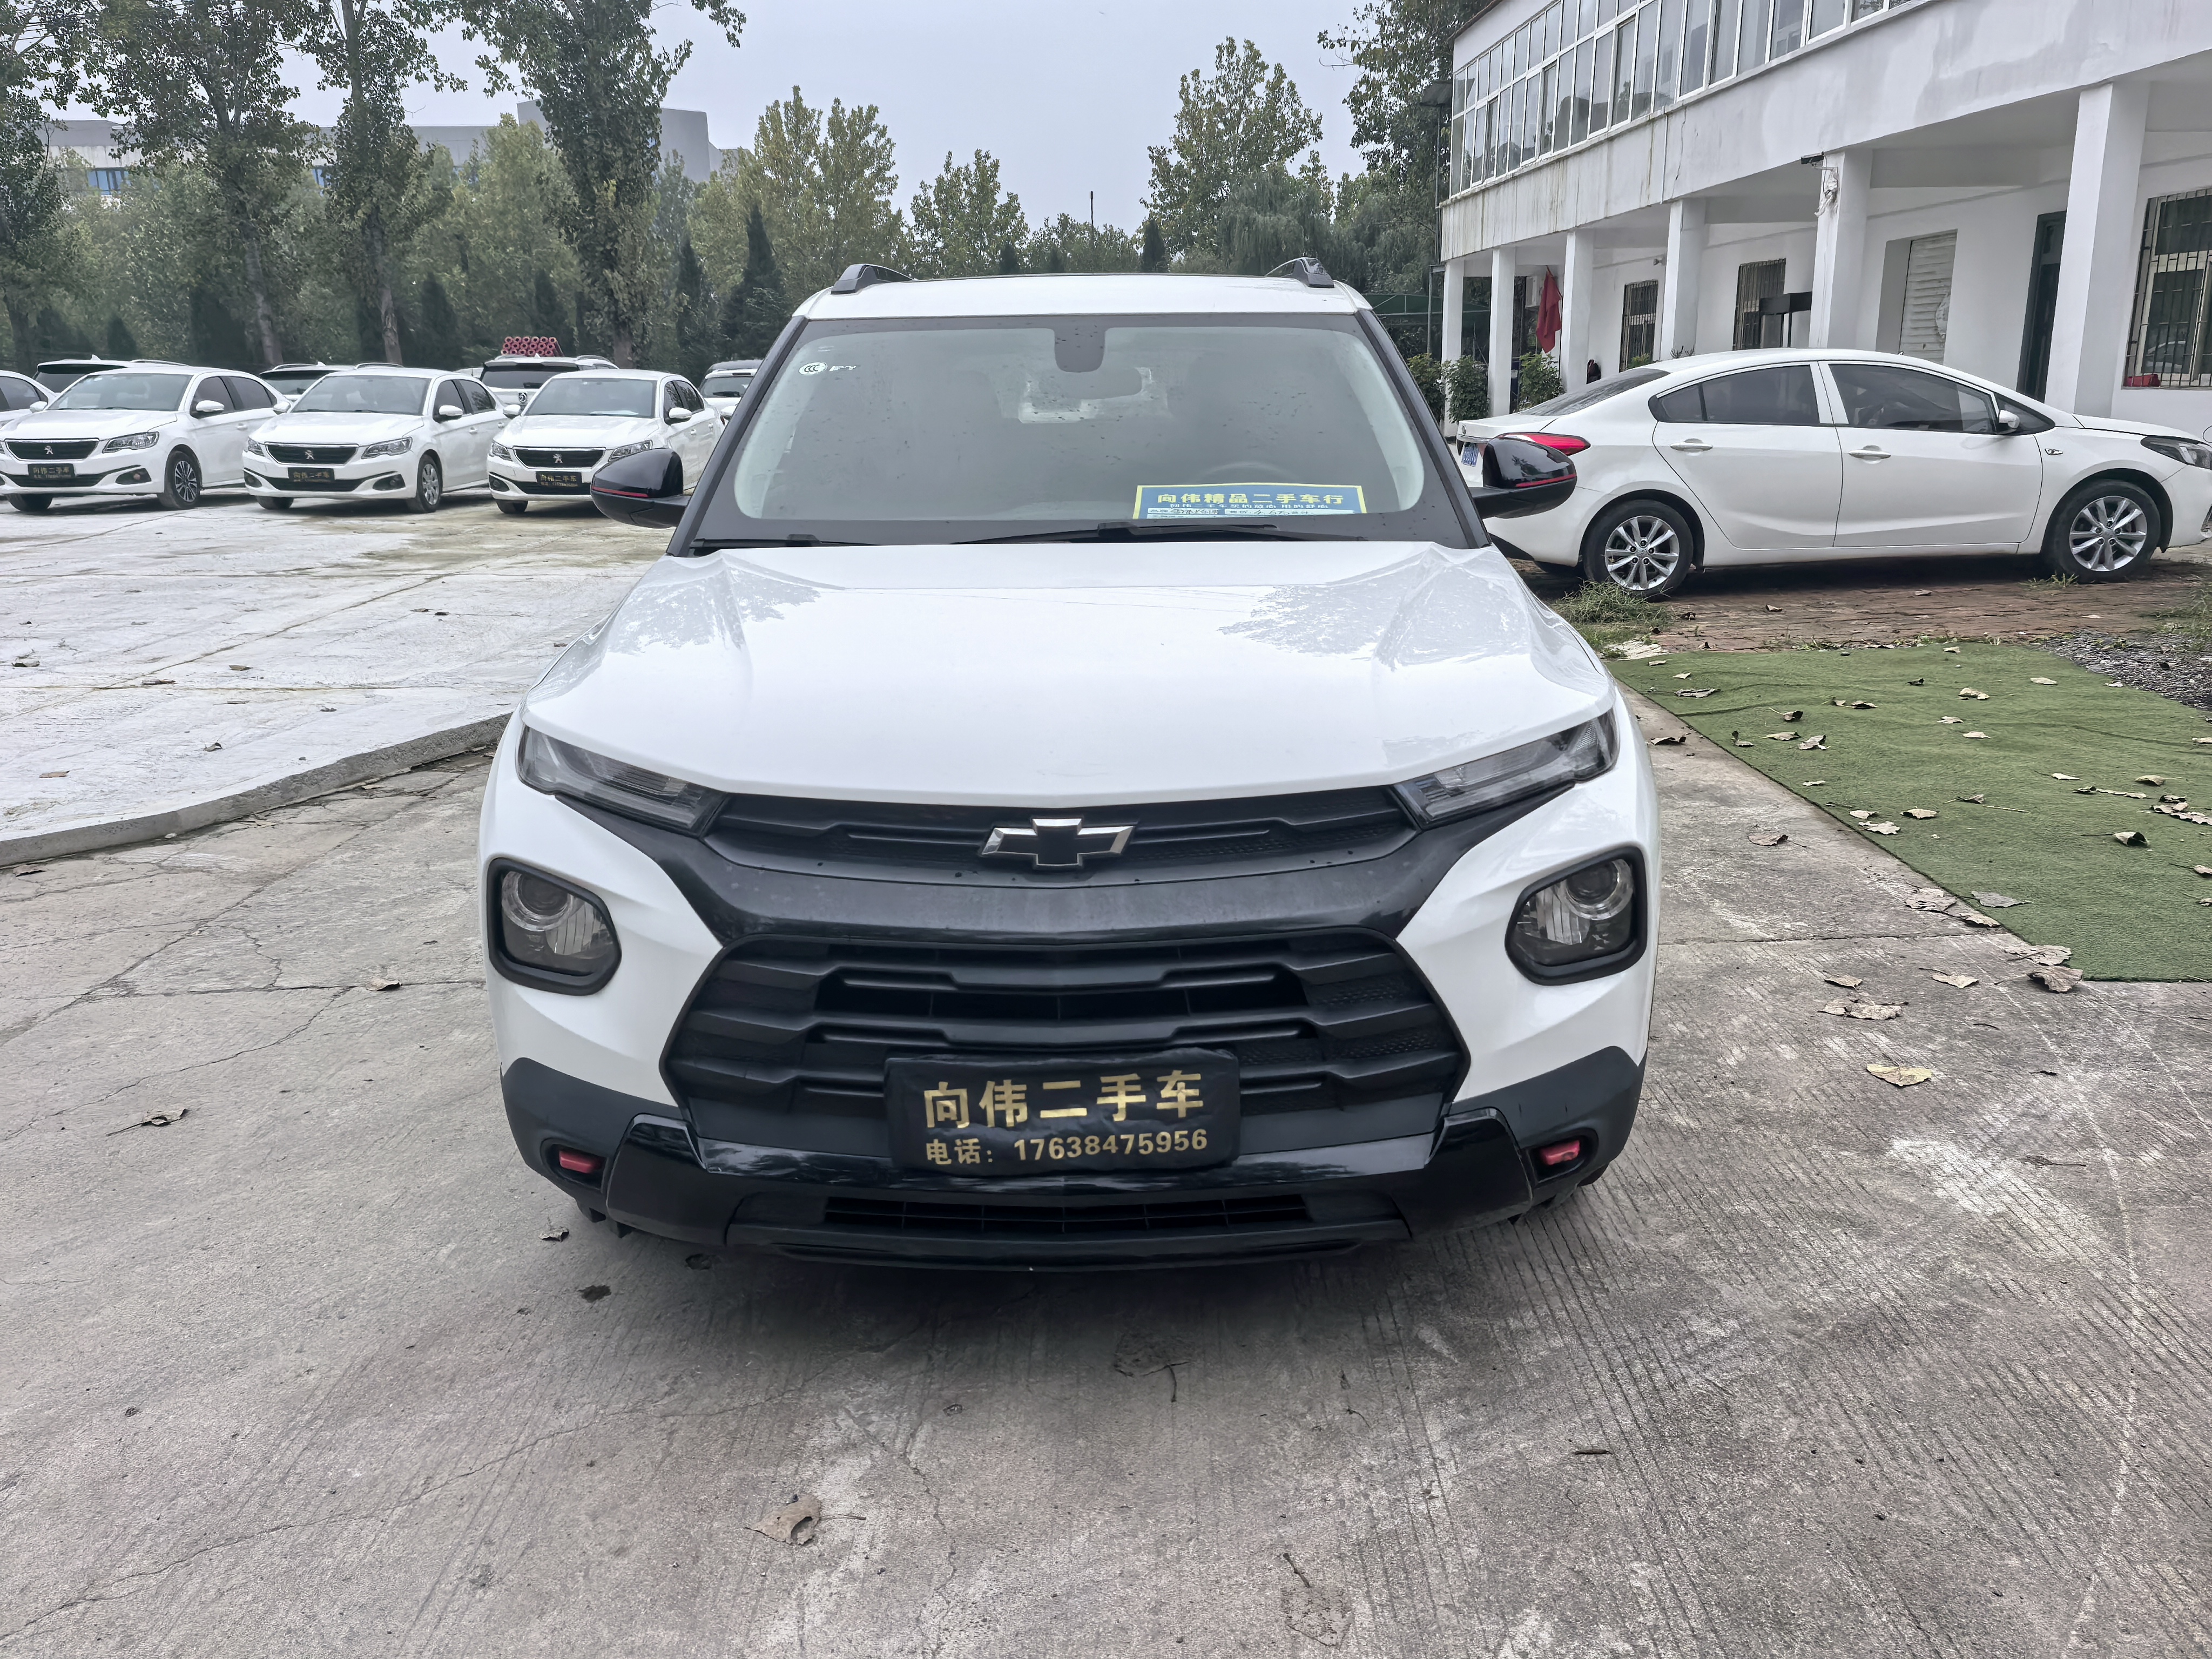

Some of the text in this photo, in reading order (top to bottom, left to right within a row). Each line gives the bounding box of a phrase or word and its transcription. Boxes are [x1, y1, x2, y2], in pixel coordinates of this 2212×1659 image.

[1157, 494, 1344, 504] 向伟精品二手车行
[923, 1070, 1204, 1128] 向伟二手车
[1013, 1129, 1209, 1161] 17638475956
